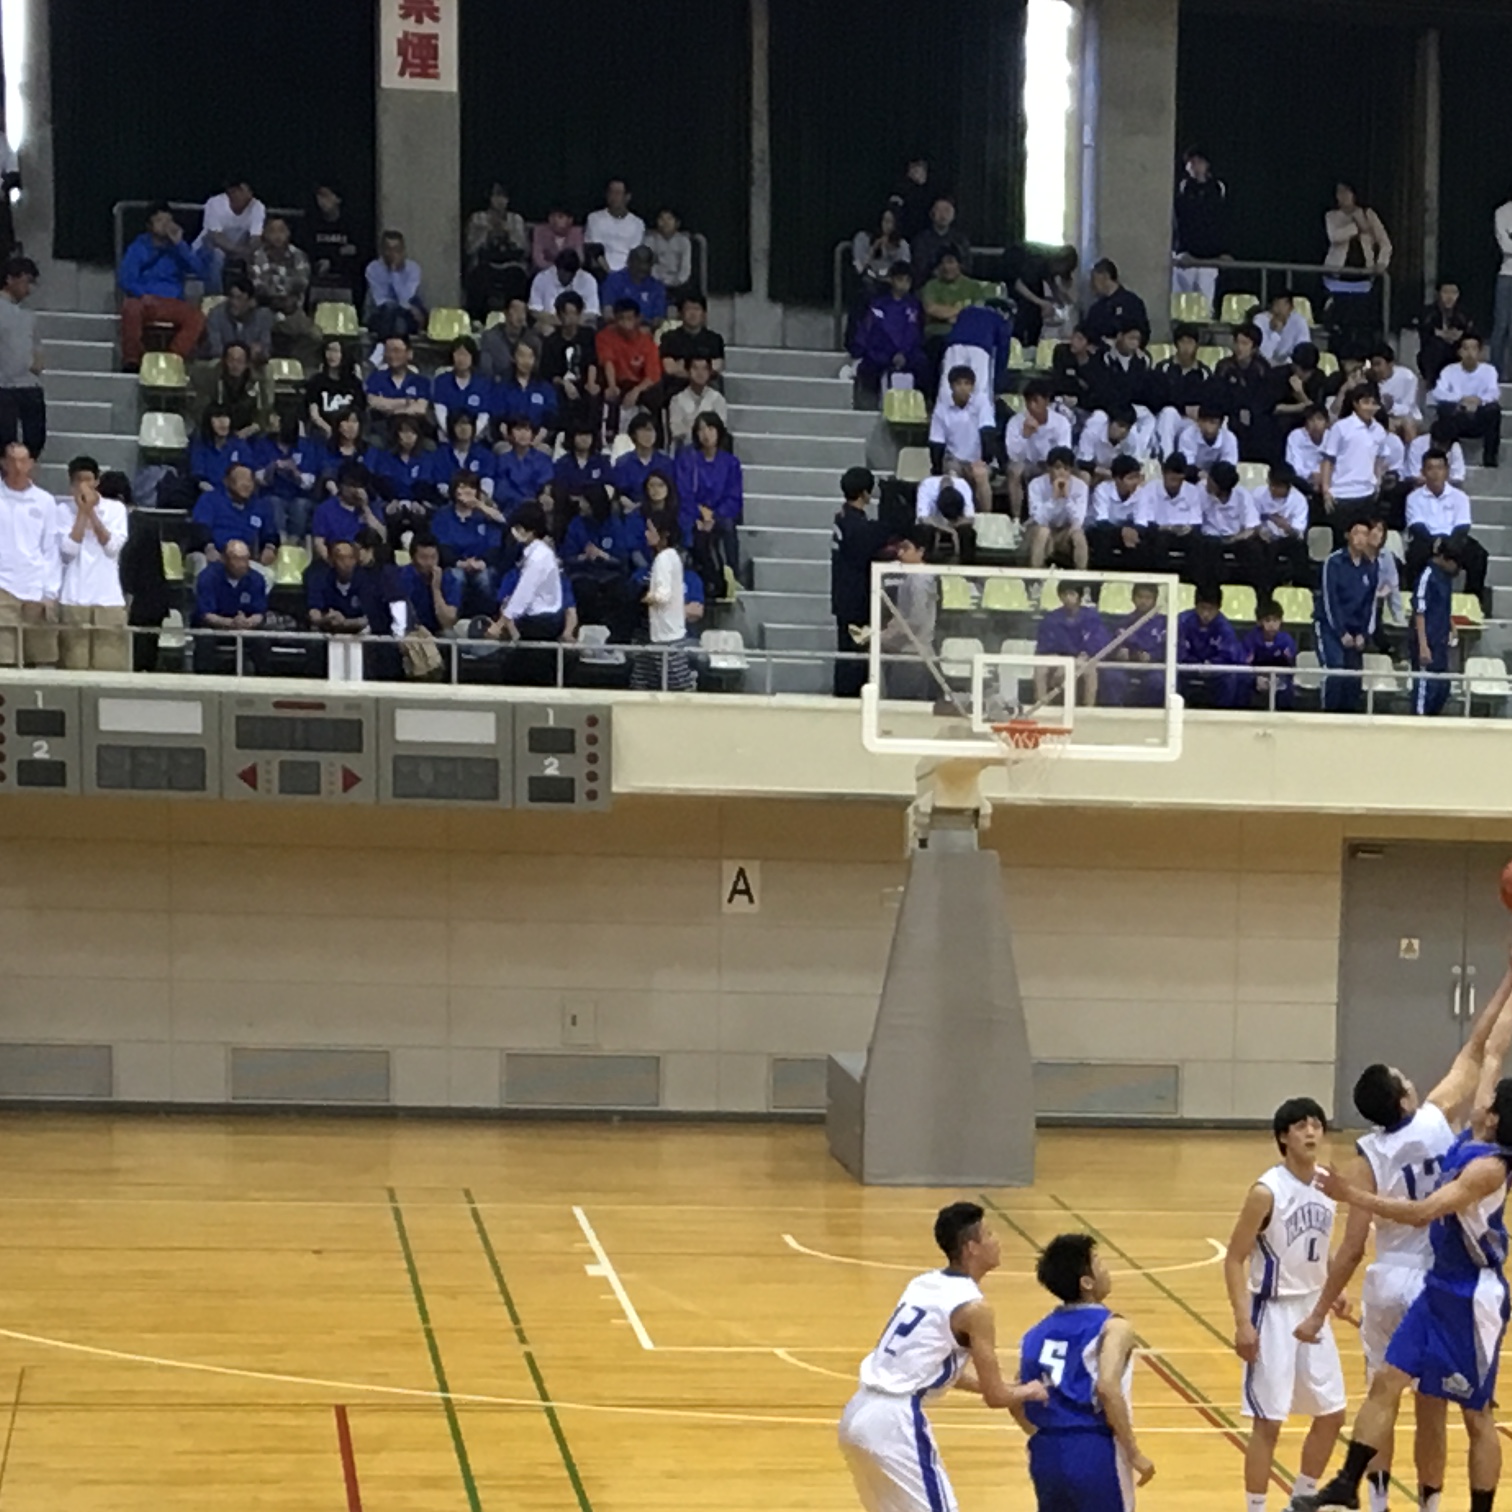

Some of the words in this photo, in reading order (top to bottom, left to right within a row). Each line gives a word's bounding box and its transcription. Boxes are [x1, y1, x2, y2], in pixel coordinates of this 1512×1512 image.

[34, 690, 44, 709] 1
[546, 707, 555, 726] 1
[32, 740, 51, 760] 2
[543, 756, 560, 776] 2
[727, 866, 755, 904] A
[875, 1302, 927, 1358] 12
[1039, 1338, 1069, 1388] 5
